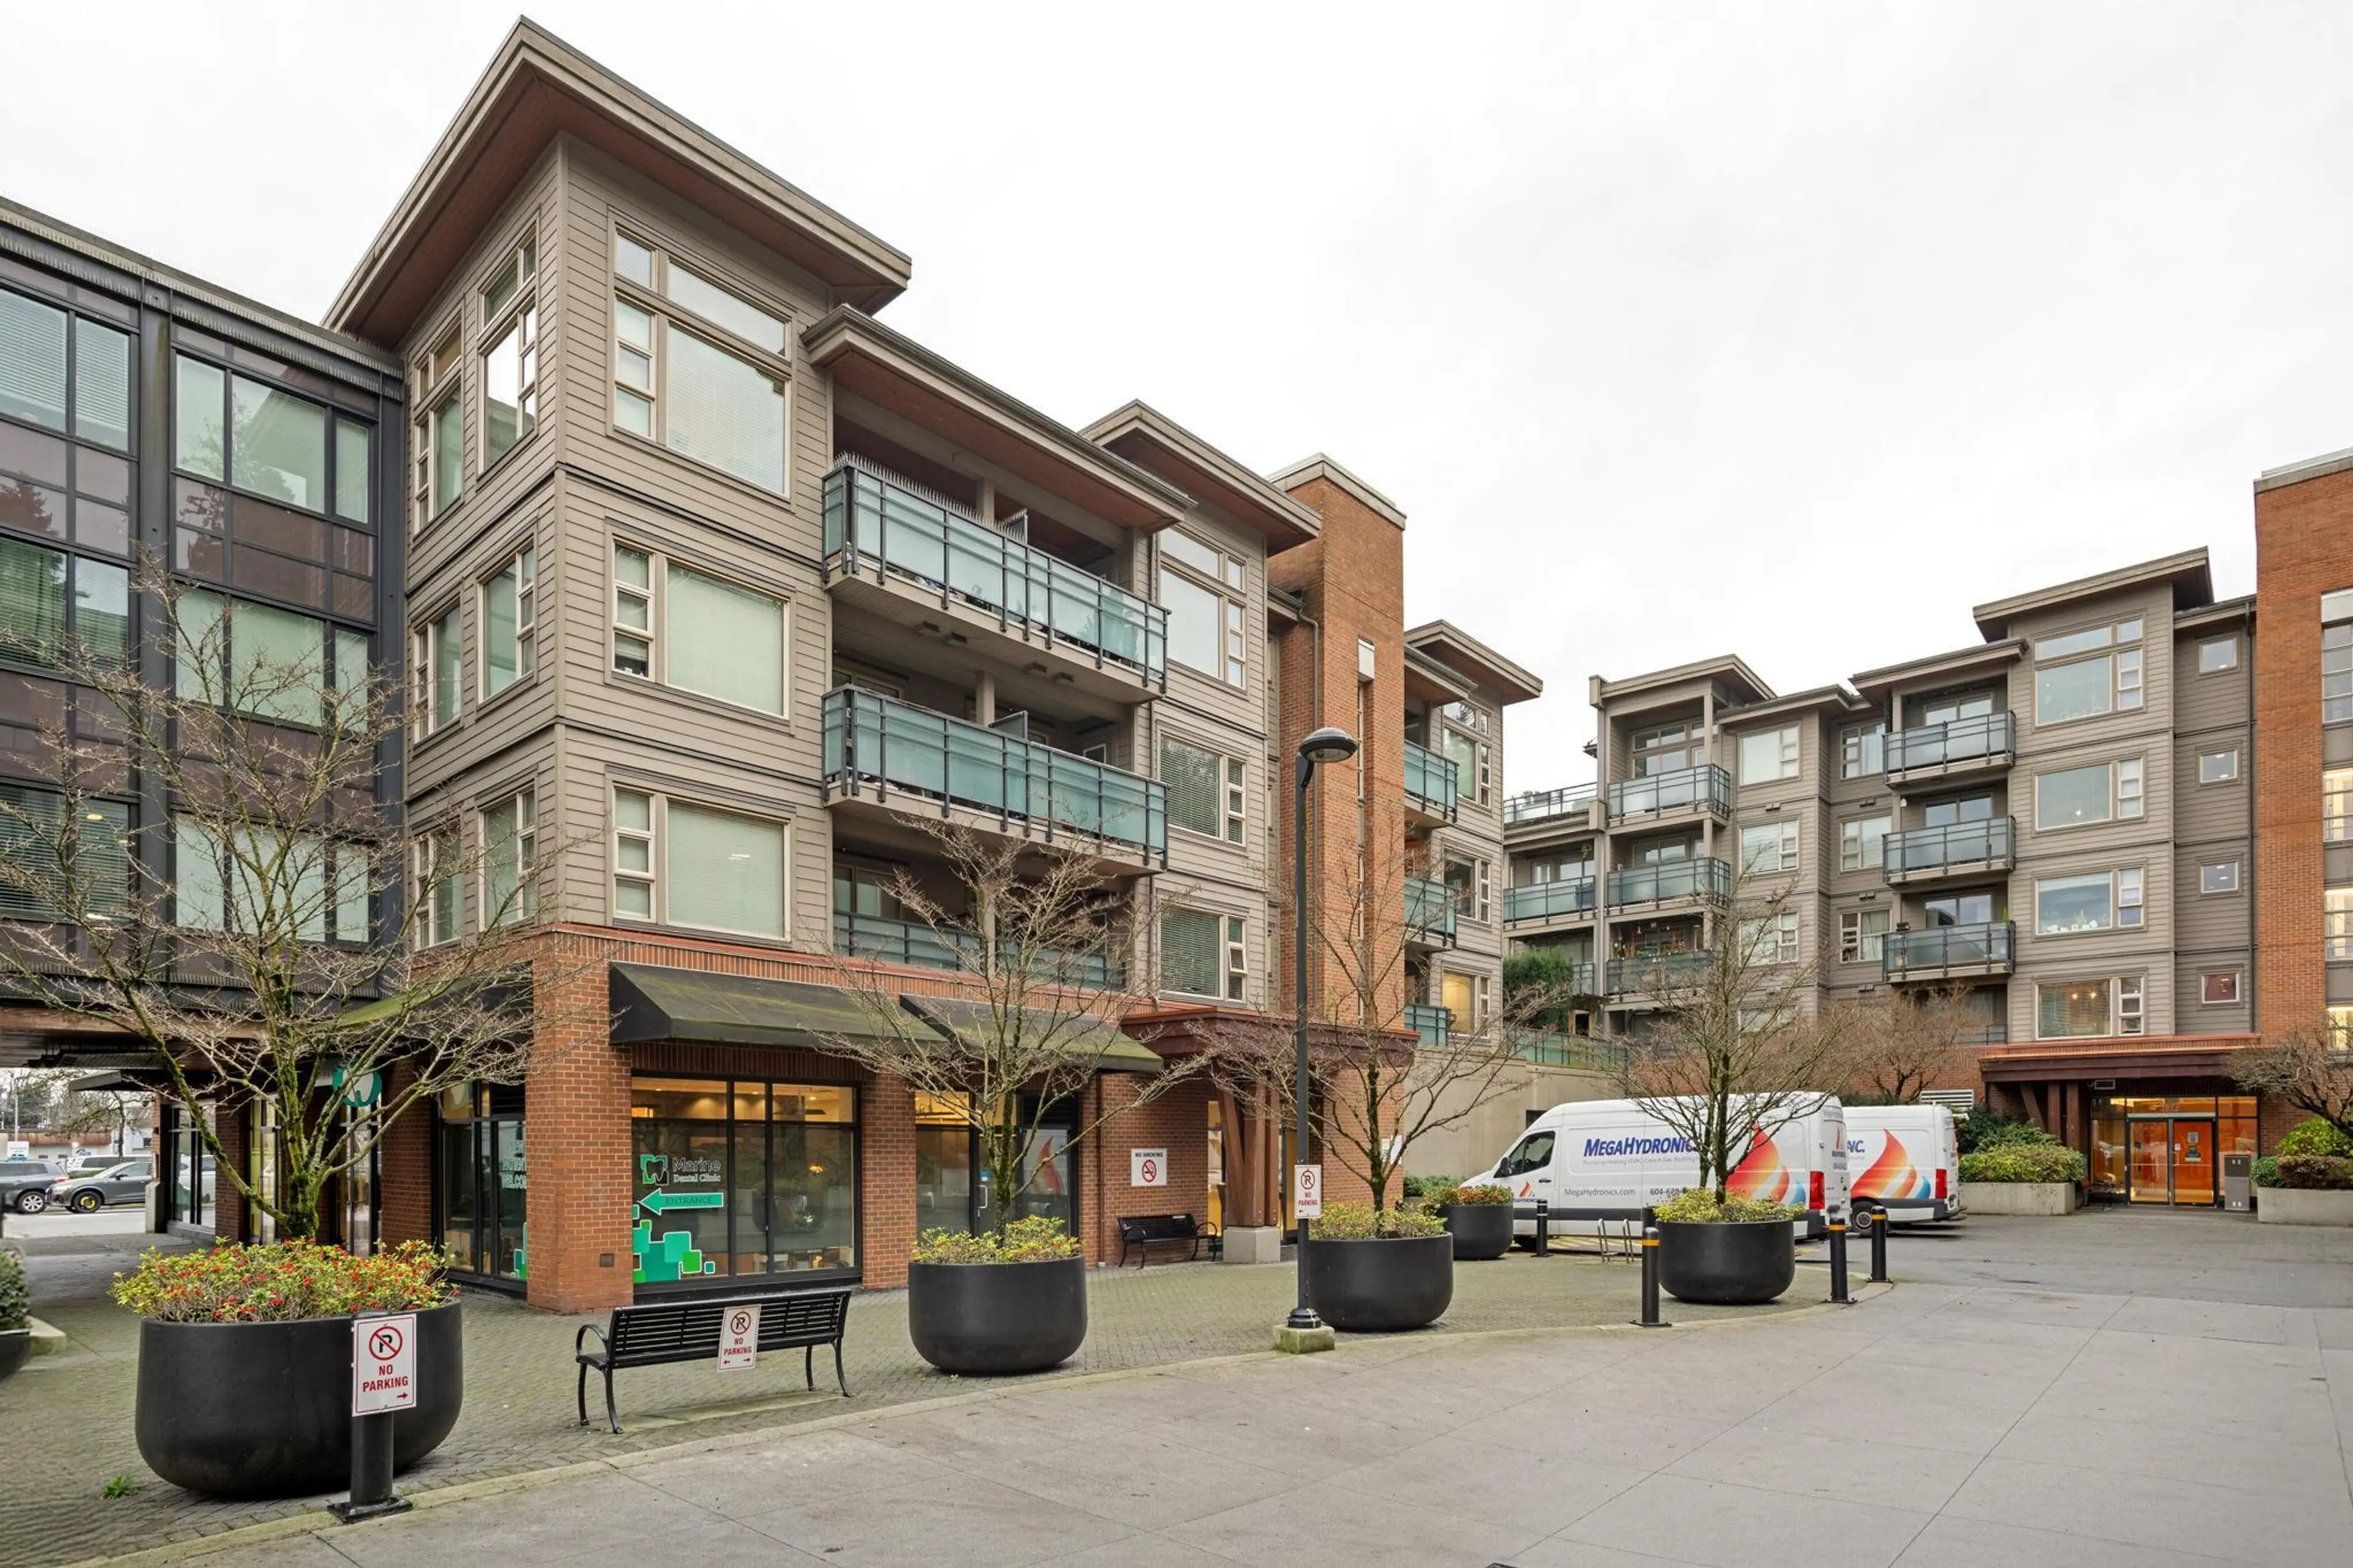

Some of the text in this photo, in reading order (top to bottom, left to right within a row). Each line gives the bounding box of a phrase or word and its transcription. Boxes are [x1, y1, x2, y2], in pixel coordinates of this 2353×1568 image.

[672, 1156, 721, 1172] Marine
[673, 1173, 721, 1183] Dental Clinic
[666, 1195, 713, 1205] ENTRANCE
[724, 1346, 752, 1355] PARKING
[379, 1364, 393, 1376] NO
[363, 1376, 409, 1392] PARKING
